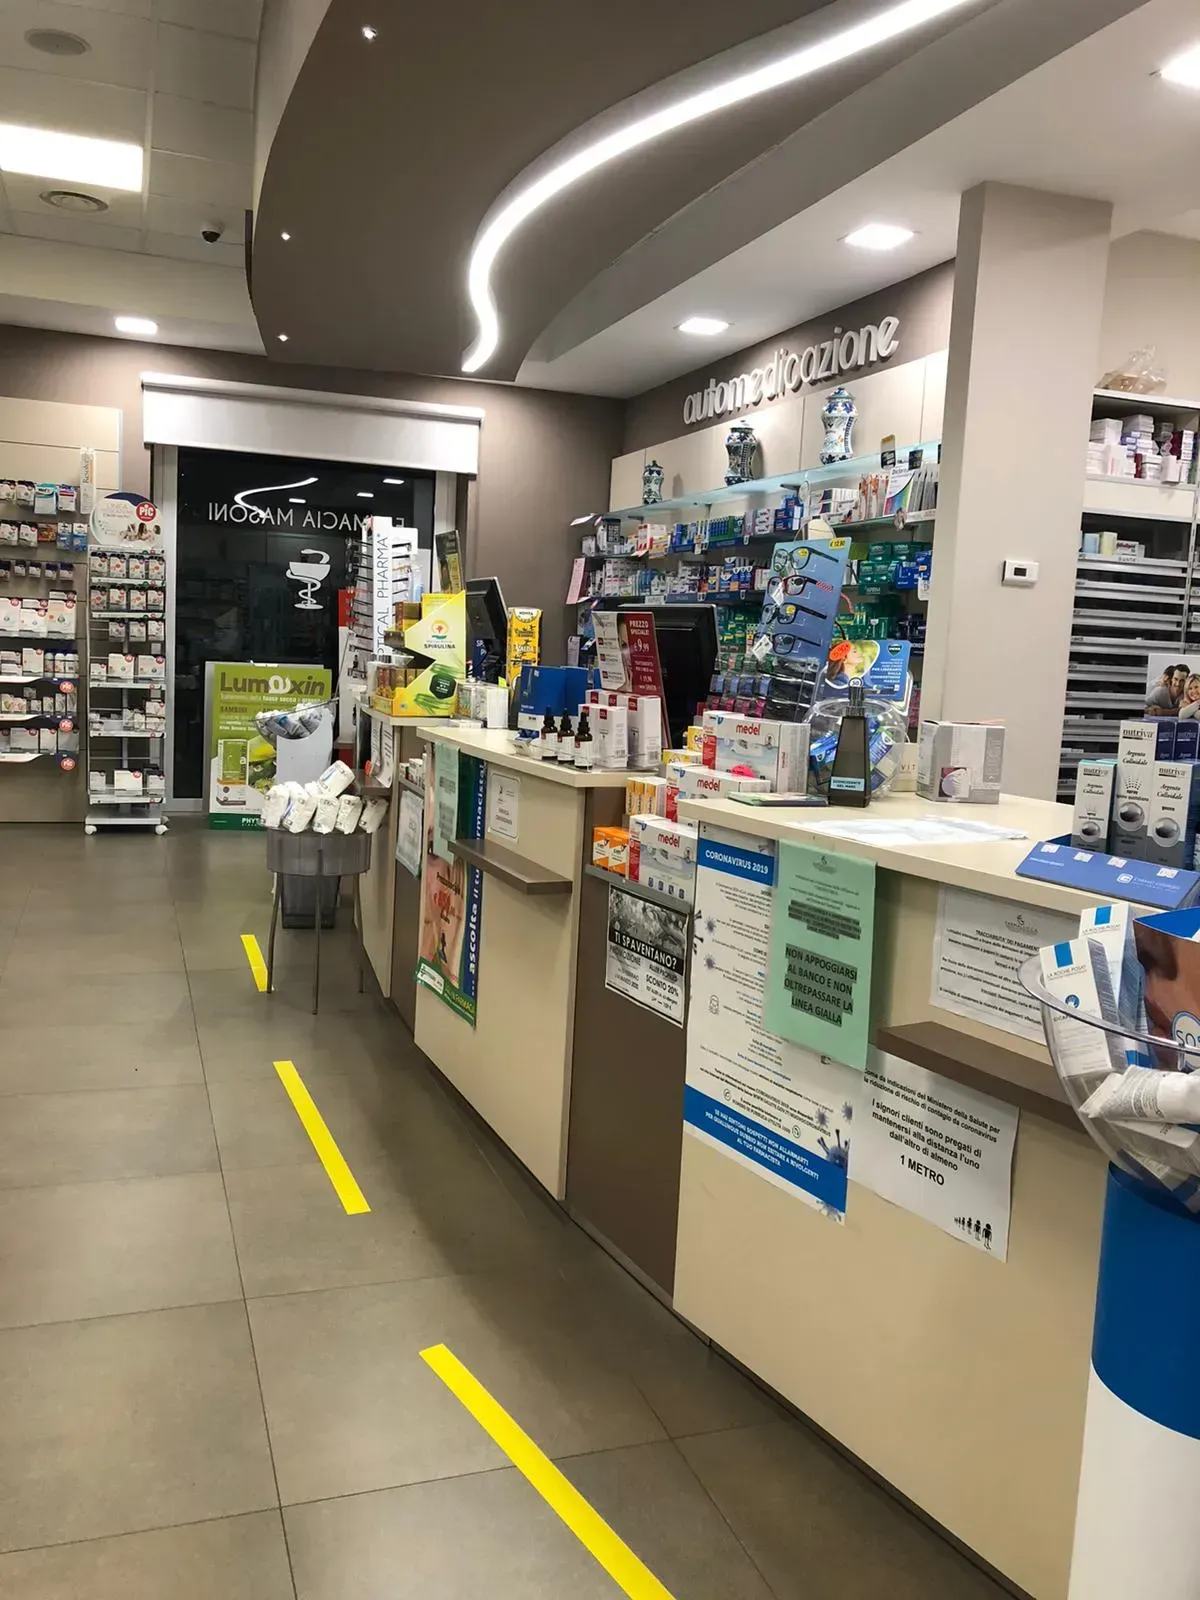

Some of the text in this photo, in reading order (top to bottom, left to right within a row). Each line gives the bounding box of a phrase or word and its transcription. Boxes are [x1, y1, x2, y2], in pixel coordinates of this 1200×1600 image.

[683, 316, 899, 424] automedicazione
[377, 607, 389, 656] PTICAL
[630, 620, 649, 628] PREZZO
[735, 723, 760, 736] medel
[1123, 727, 1154, 738] nutriva
[696, 778, 720, 792] medel
[1159, 767, 1186, 776] nutriva
[657, 833, 681, 849] medel
[705, 849, 769, 875] CORONAVIRUS 2019
[468, 903, 478, 973] ascolta
[622, 935, 677, 969] SPAVENTANO?
[786, 944, 803, 961] NON
[805, 953, 857, 981] APPOGGIARSI
[646, 974, 679, 997] SCONTO 20%
[784, 978, 841, 1009] OLTREPASSARE
[843, 1001, 853, 1013] LA
[787, 965, 852, 995] AL BANCO E NON
[791, 997, 842, 1025] LINEA GIALLA
[869, 1078, 894, 1095] riduzione
[894, 1088, 900, 1097] di
[901, 1092, 920, 1107] rischio
[920, 1100, 927, 1109] di
[927, 1104, 952, 1122] contagio
[952, 1116, 960, 1125] da
[960, 1120, 997, 1143] coronavirus
[886, 1077, 916, 1095] indicazioni
[917, 1090, 926, 1100] del
[927, 1095, 953, 1113] Ministero
[953, 1108, 968, 1120] della
[968, 1113, 988, 1128] Salute
[989, 1123, 1000, 1134] per
[705, 1111, 713, 1119] PER
[740, 1129, 757, 1145] DUBBIO
[757, 1138, 767, 1149] NON
[767, 1144, 786, 1161] ESITARE
[790, 1158, 819, 1180] RIVOLGERTI
[728, 1115, 747, 1131] SINTOMI
[747, 1124, 768, 1142] SOSPETTI
[768, 1137, 779, 1148] NON
[779, 1143, 809, 1166] ALLARMARTI
[872, 1110, 980, 1170] mantenersi alla distanza l'uno
[876, 1100, 900, 1119] signori
[901, 1112, 923, 1130] clienti
[924, 1124, 944, 1140] sono
[944, 1135, 972, 1157] pregati
[973, 1146, 982, 1158] di
[743, 1141, 753, 1151] TUO
[753, 1146, 781, 1167] FARMACISTA
[889, 1130, 958, 1171] dall'altro di almeno
[900, 1154, 945, 1186] 1 METRO
